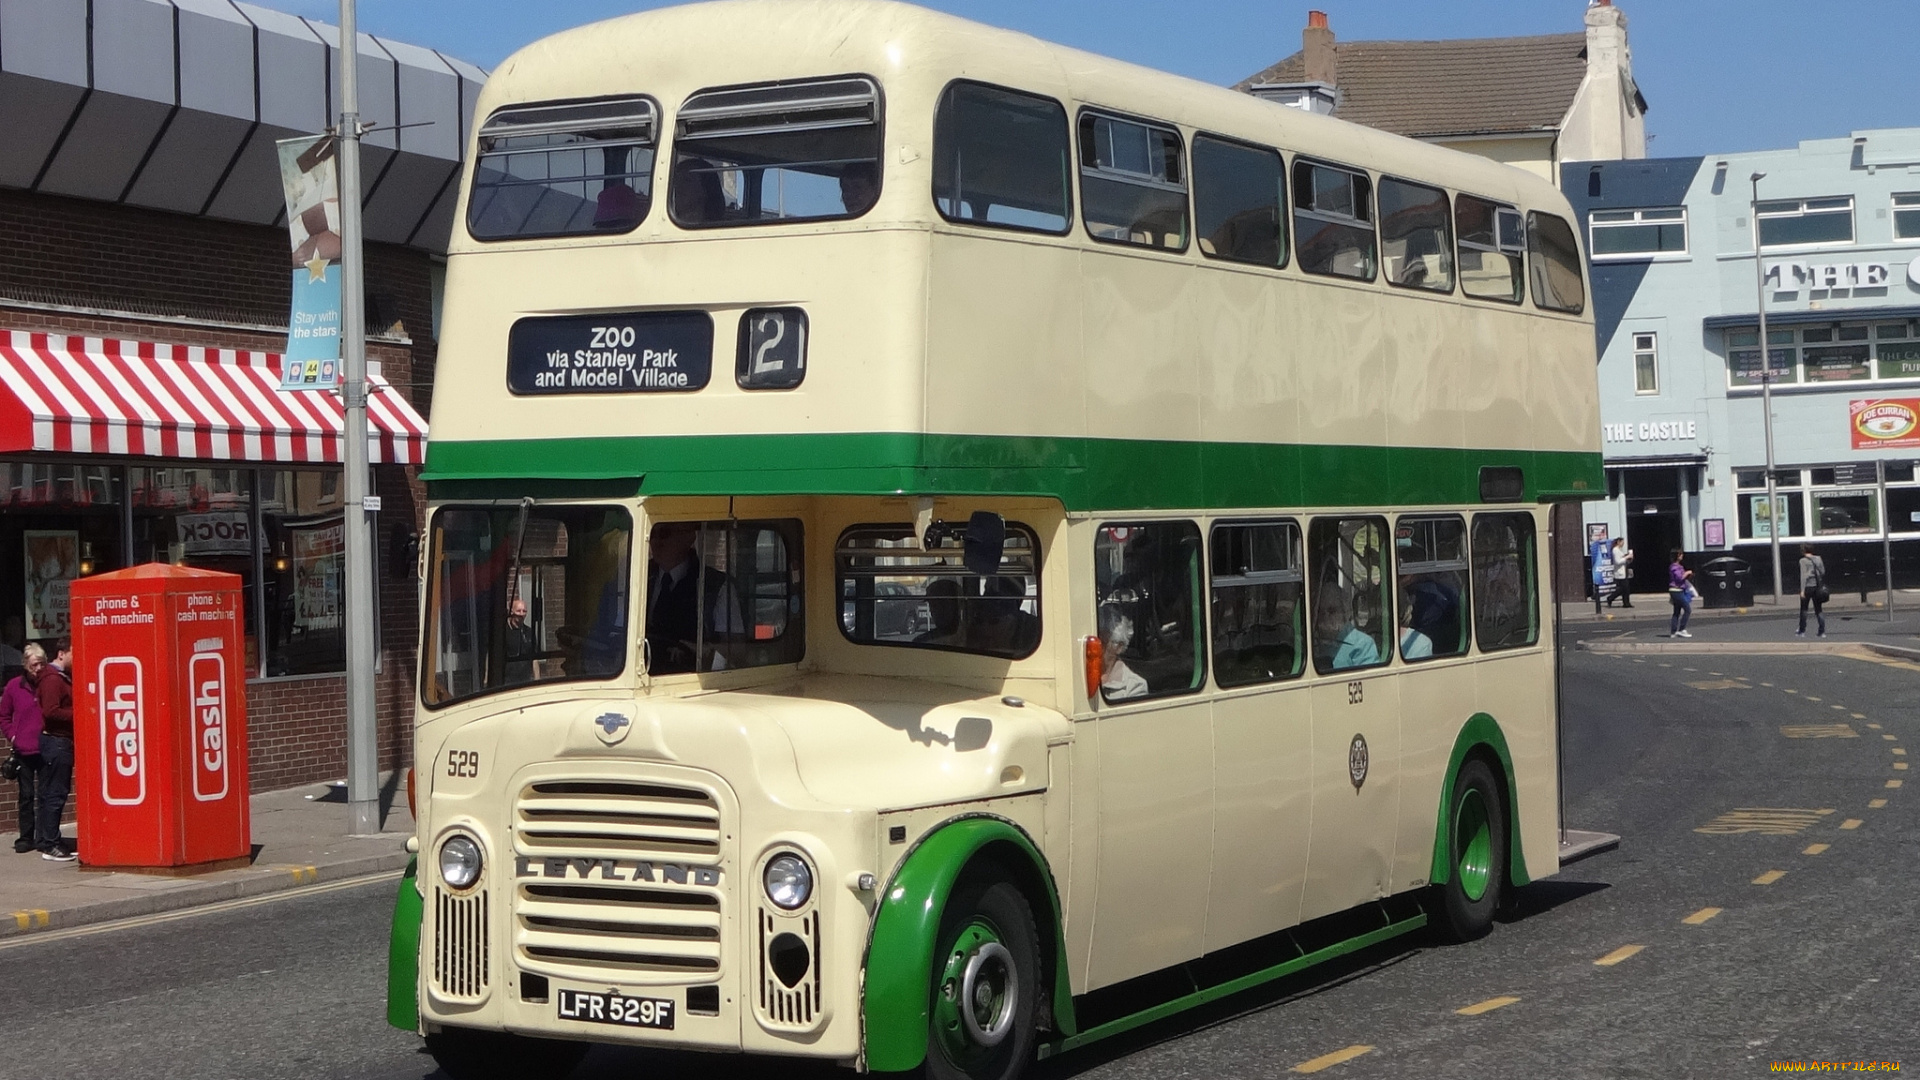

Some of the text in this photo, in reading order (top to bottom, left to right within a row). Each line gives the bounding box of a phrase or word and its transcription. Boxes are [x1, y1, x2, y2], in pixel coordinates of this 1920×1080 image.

[1764, 261, 1890, 292] THE
[294, 310, 338, 325] Stay with
[294, 326, 337, 338] the stars
[590, 326, 636, 348] ZOO
[754, 312, 785, 374] 2
[546, 349, 678, 372] via Stanley Park
[535, 367, 688, 387] and Model Village
[1863, 409, 1877, 422] JOE
[1877, 406, 1910, 419] CURRAN
[1604, 421, 1696, 441] THE CASTLE
[96, 595, 140, 613] phone &
[188, 593, 213, 608] phone
[83, 611, 154, 626] cash machine
[177, 607, 235, 622] cash machine
[1348, 682, 1363, 705] 529
[107, 684, 138, 777] cash
[196, 679, 222, 772] cash
[447, 749, 479, 778] 529
[516, 857, 725, 886] LEYLAND
[560, 993, 672, 1026] LFR 529F
